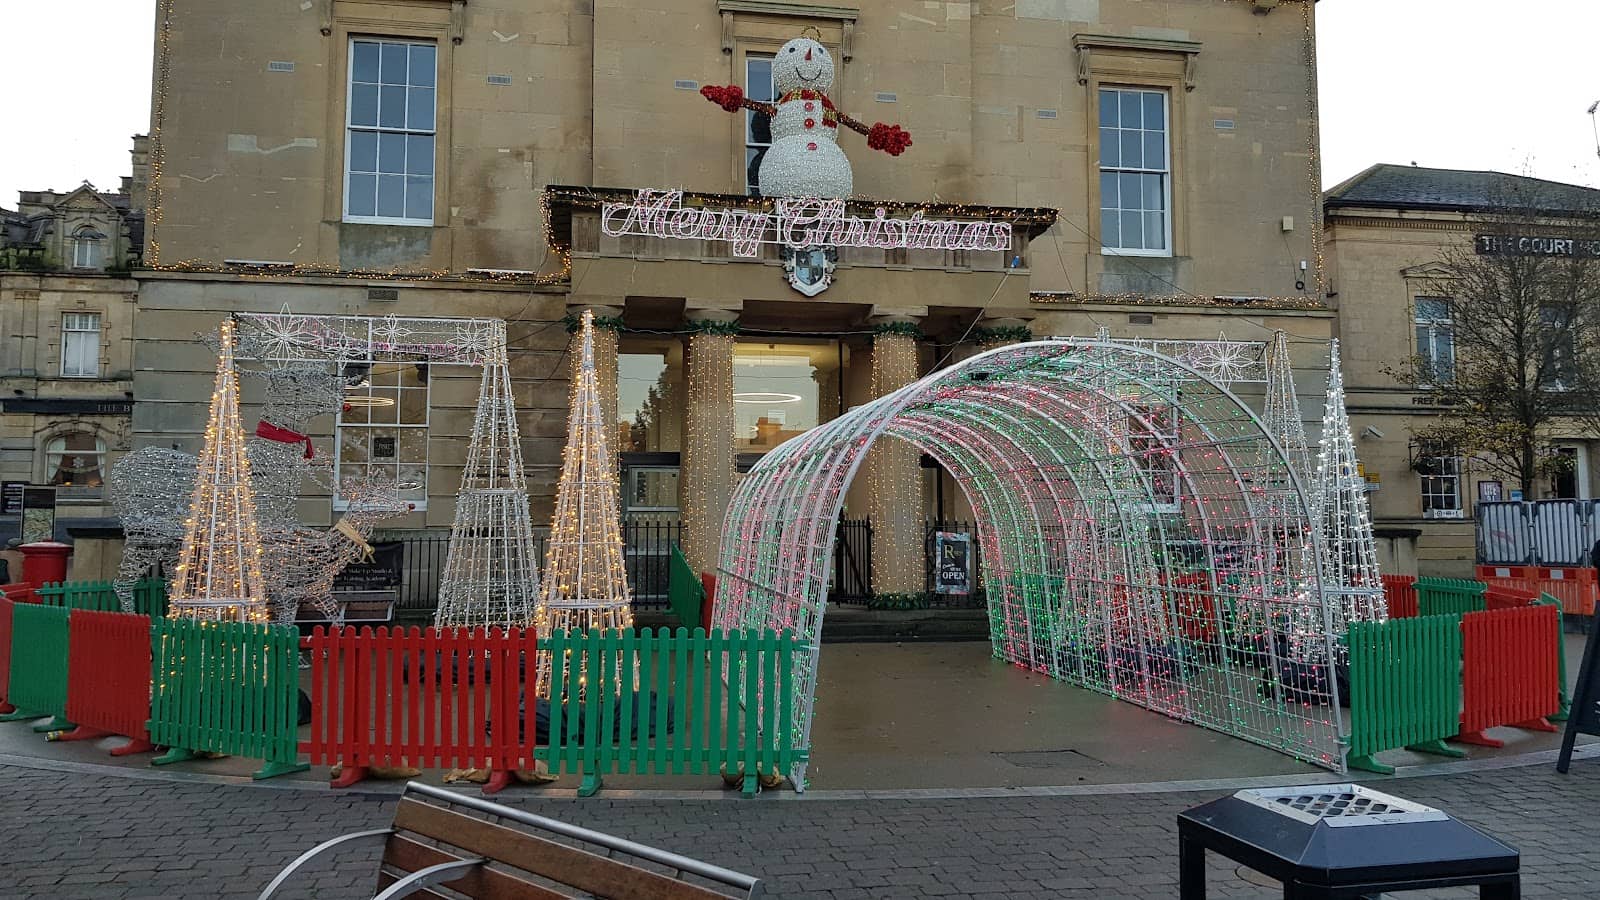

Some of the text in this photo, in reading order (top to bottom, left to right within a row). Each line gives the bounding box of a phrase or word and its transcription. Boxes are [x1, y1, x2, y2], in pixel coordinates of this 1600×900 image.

[602, 190, 1012, 257] Merry Christmas
[1519, 238, 1574, 254] COURT
[942, 571, 965, 580] OPEN
